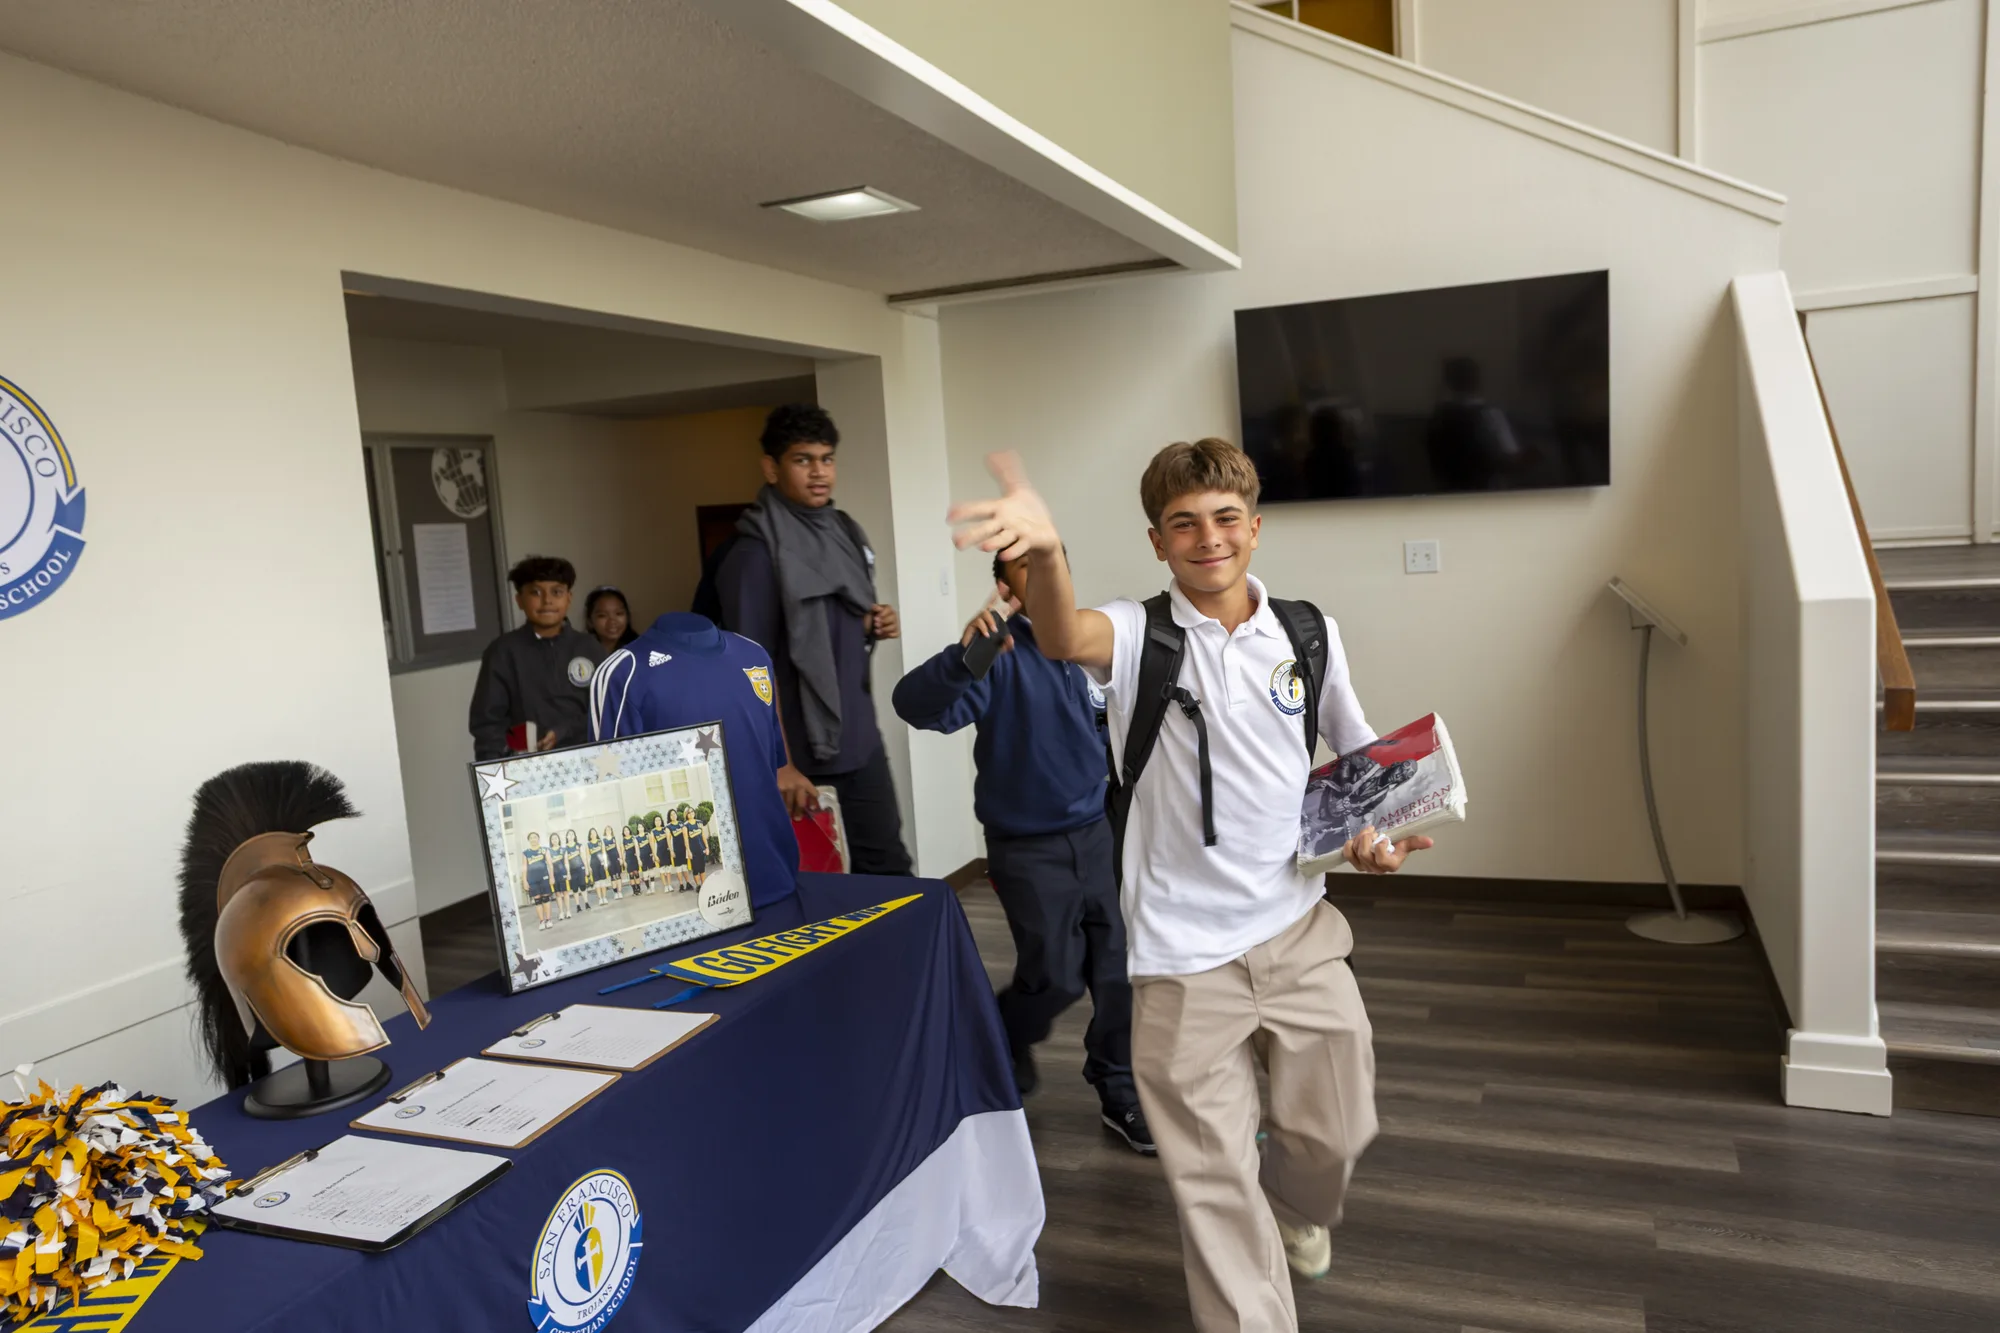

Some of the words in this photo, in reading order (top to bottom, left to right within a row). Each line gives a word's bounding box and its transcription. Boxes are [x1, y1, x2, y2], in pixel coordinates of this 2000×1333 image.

[0, 396, 57, 477] ISCO
[1379, 784, 1451, 825] AMERICAN
[1387, 798, 1444, 830] REPUBLI
[693, 949, 776, 975] GO
[741, 920, 848, 957] FIGHT
[836, 905, 888, 922] WIN
[539, 1231, 559, 1280] SAN
[557, 1179, 632, 1226] FRANCISCO
[577, 1284, 613, 1320] TROJANS
[606, 1257, 637, 1316] SCHOOL
